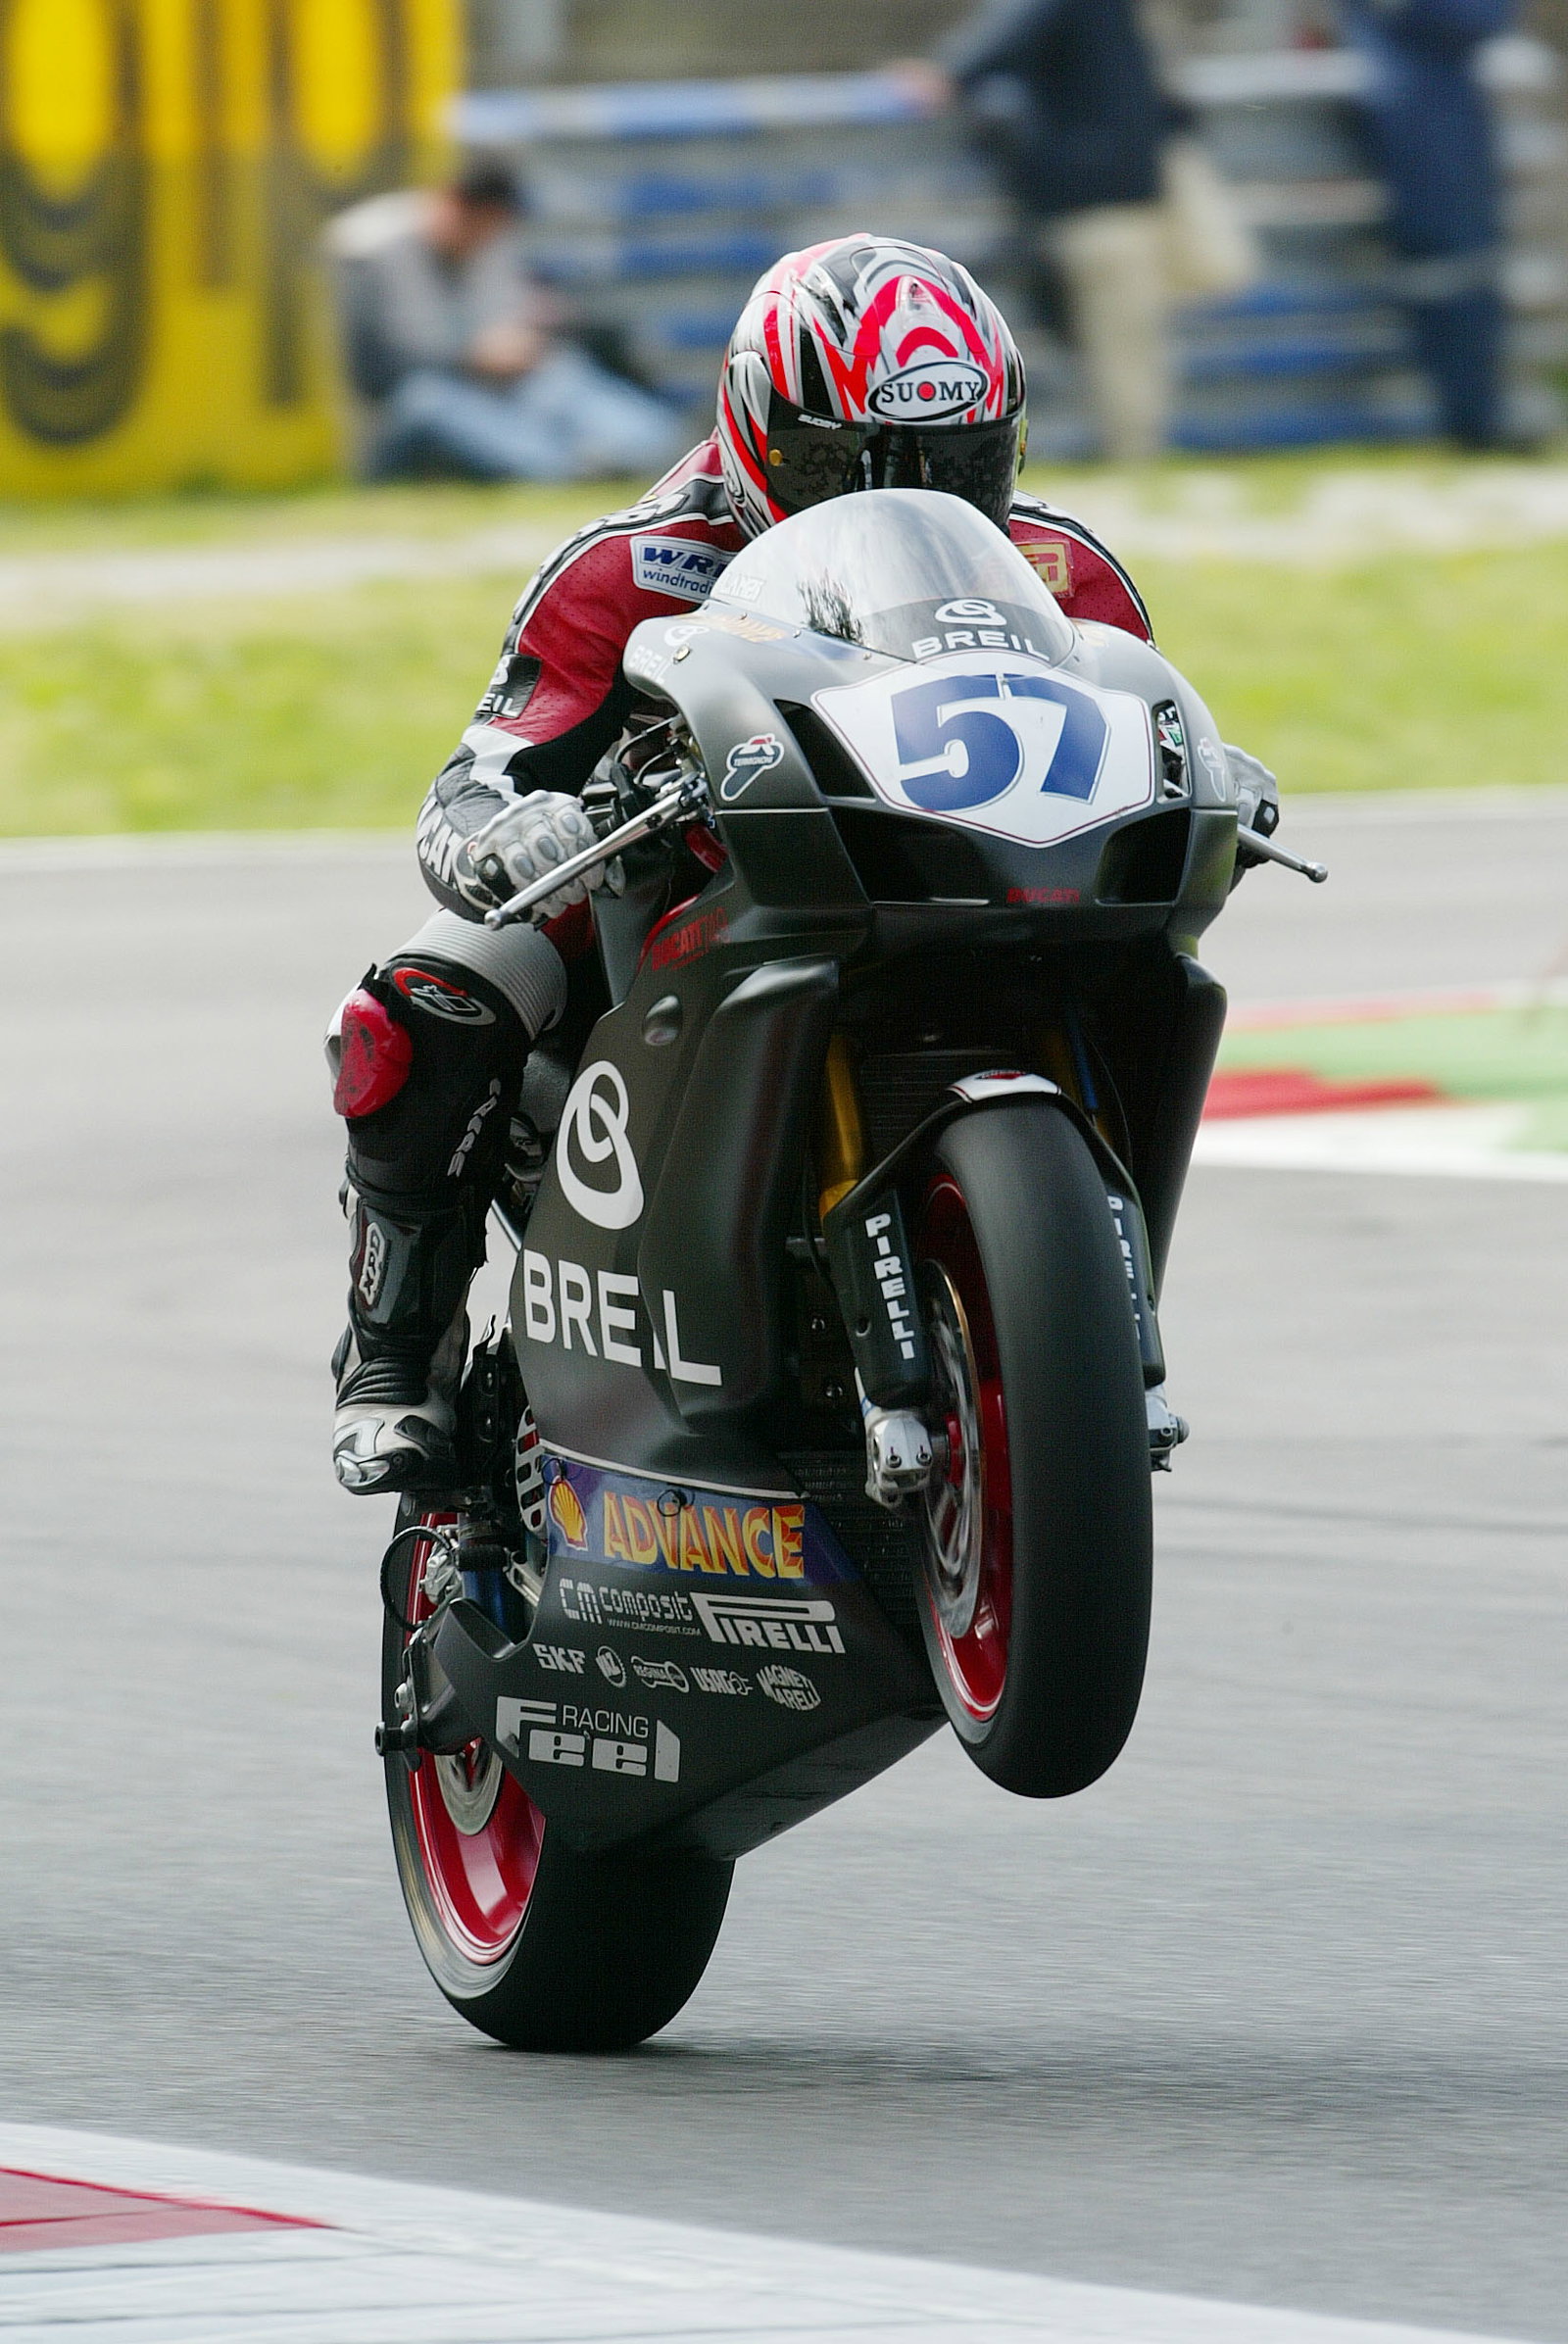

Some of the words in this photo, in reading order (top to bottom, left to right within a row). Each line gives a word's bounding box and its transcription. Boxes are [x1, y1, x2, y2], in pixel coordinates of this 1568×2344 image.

[881, 380, 981, 405] SUOMY
[643, 567, 714, 596] windtradi
[910, 629, 1052, 661] BREIL
[627, 643, 665, 685] BREIL
[476, 692, 519, 717] EIL
[890, 672, 1110, 812] 57
[1005, 886, 1081, 903] DUCATI
[864, 1212, 915, 1360] PIRELLI
[603, 1490, 806, 1579] ADVANCE
[598, 1586, 694, 1622] composit
[689, 1591, 847, 1655] PIRELLI
[532, 1642, 586, 1675] SKF
[562, 1704, 649, 1738] RACING
